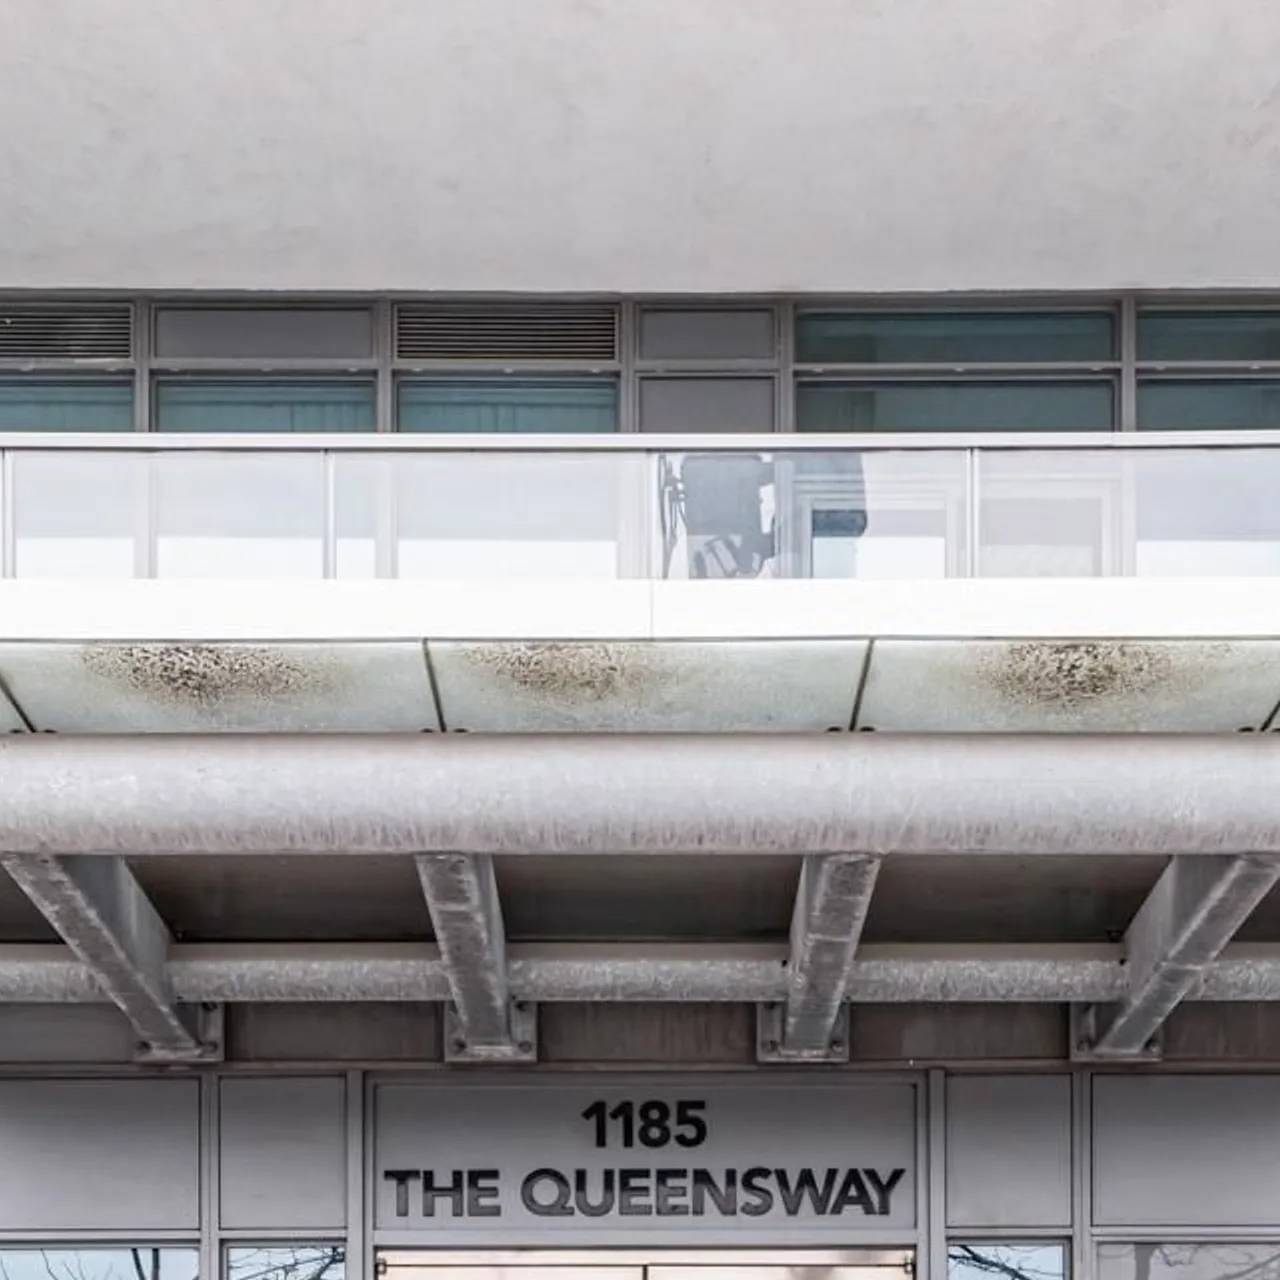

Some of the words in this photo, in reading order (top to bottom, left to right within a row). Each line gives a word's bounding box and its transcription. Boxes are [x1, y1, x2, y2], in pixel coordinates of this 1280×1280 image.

[581, 1099, 708, 1149] 1185
[384, 1169, 502, 1218] THE
[520, 1167, 907, 1218] QUEENSWAY
